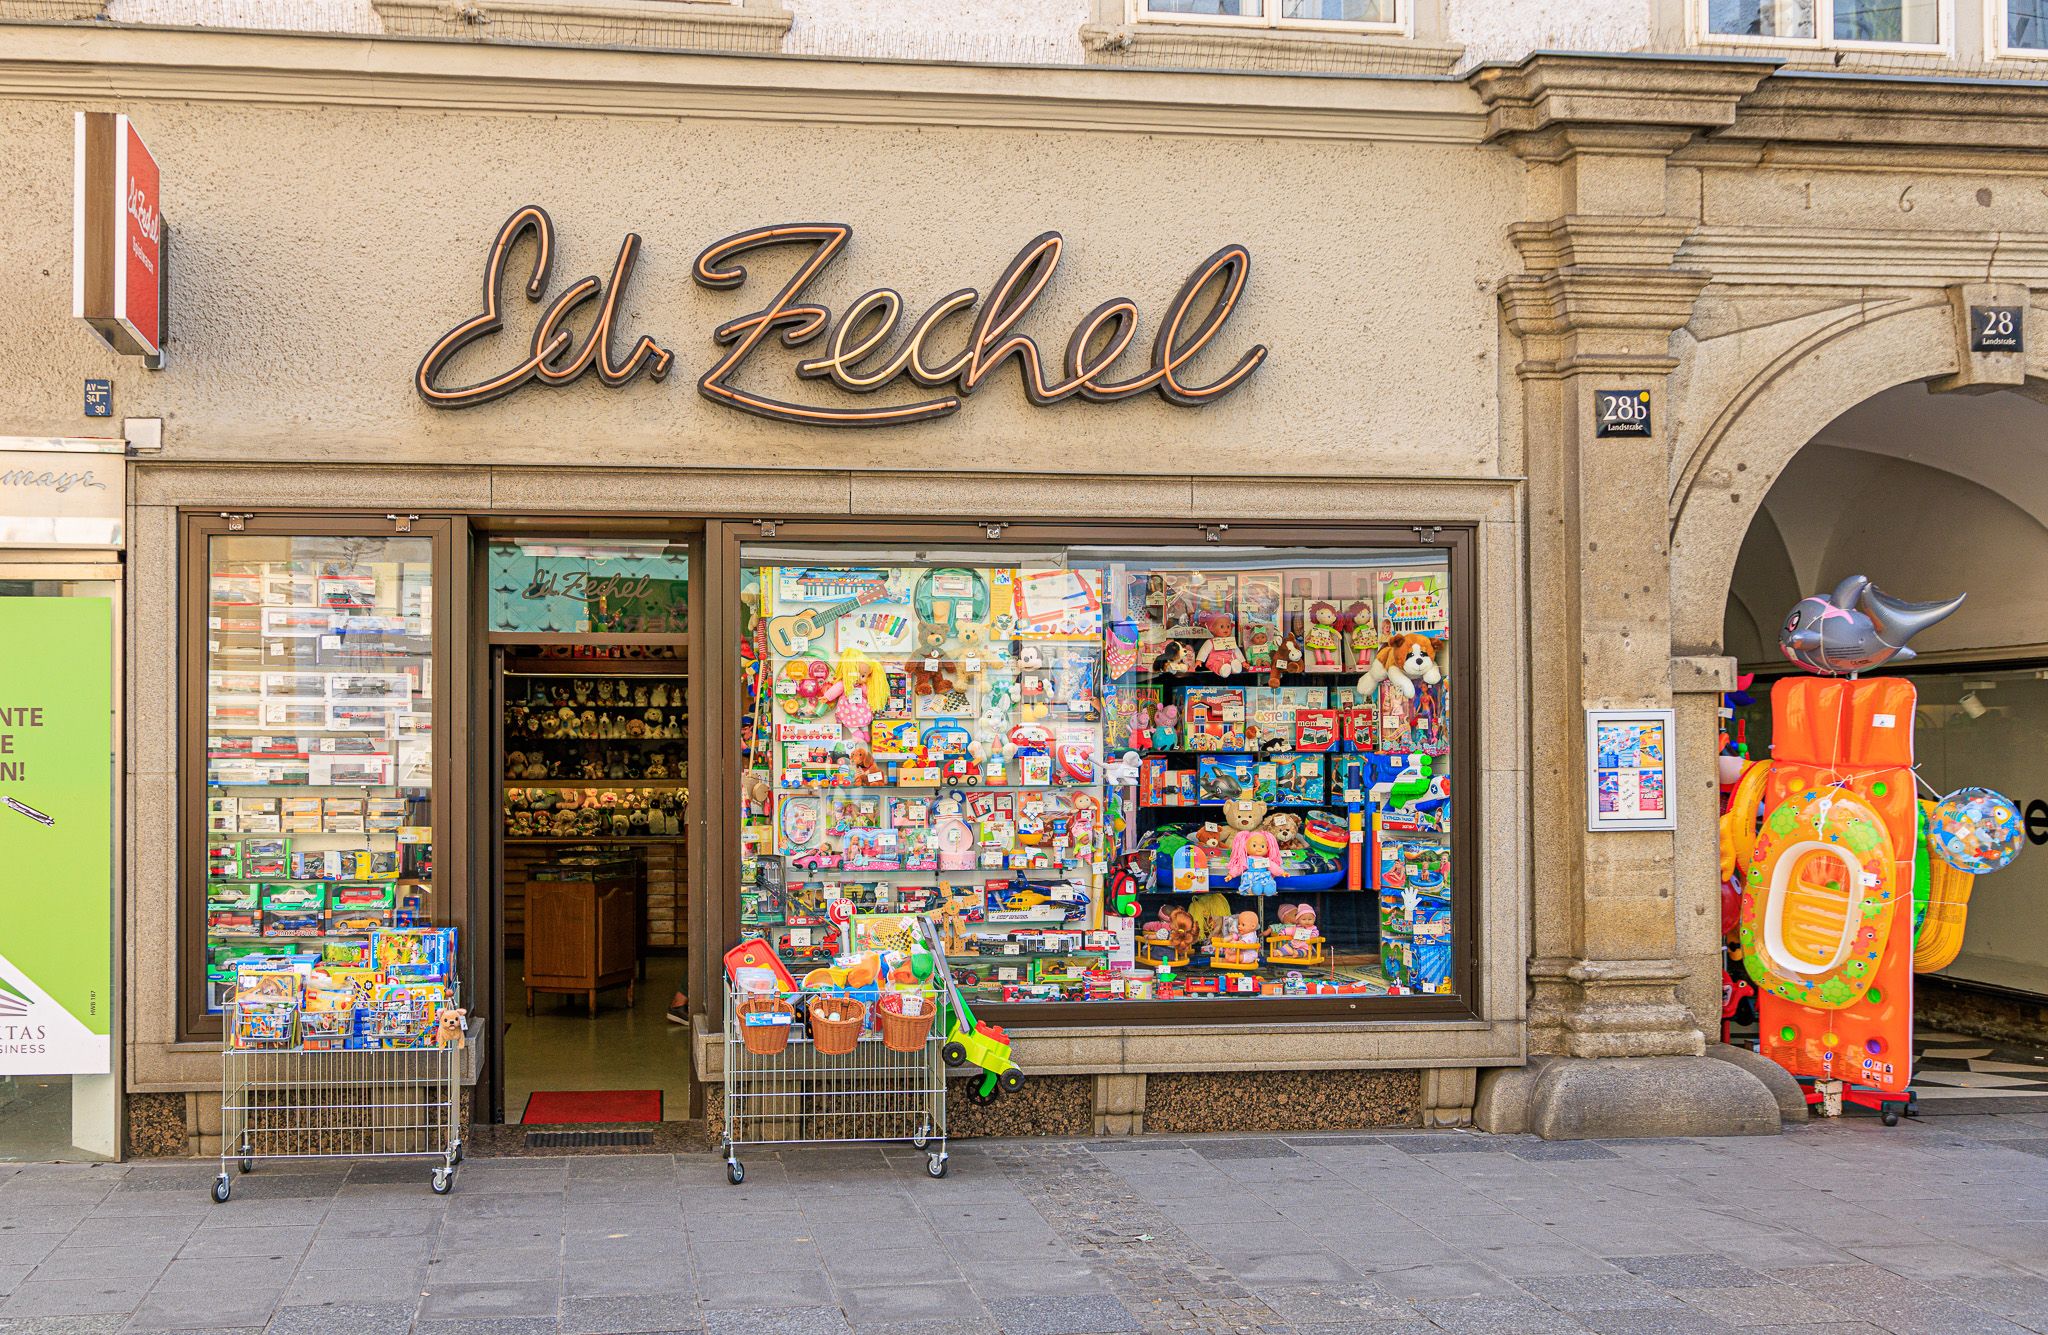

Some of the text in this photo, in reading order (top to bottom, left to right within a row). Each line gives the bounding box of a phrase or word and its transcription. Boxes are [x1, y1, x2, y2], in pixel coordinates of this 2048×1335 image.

[692, 223, 1268, 428] Zechel
[1982, 311, 2014, 335] 28
[1982, 337, 2016, 345] Landstraße
[86, 383, 96, 391] AV
[1603, 396, 1647, 420] 28b
[1607, 422, 1643, 431] Landstraße
[556, 571, 653, 602] Zechel
[1192, 627, 1204, 635] Set
[0, 708, 43, 727] NTE
[1, 735, 14, 754] E
[0, 762, 25, 781] N!
[832, 897, 853, 908] STOP
[0, 1025, 46, 1040] TAS
